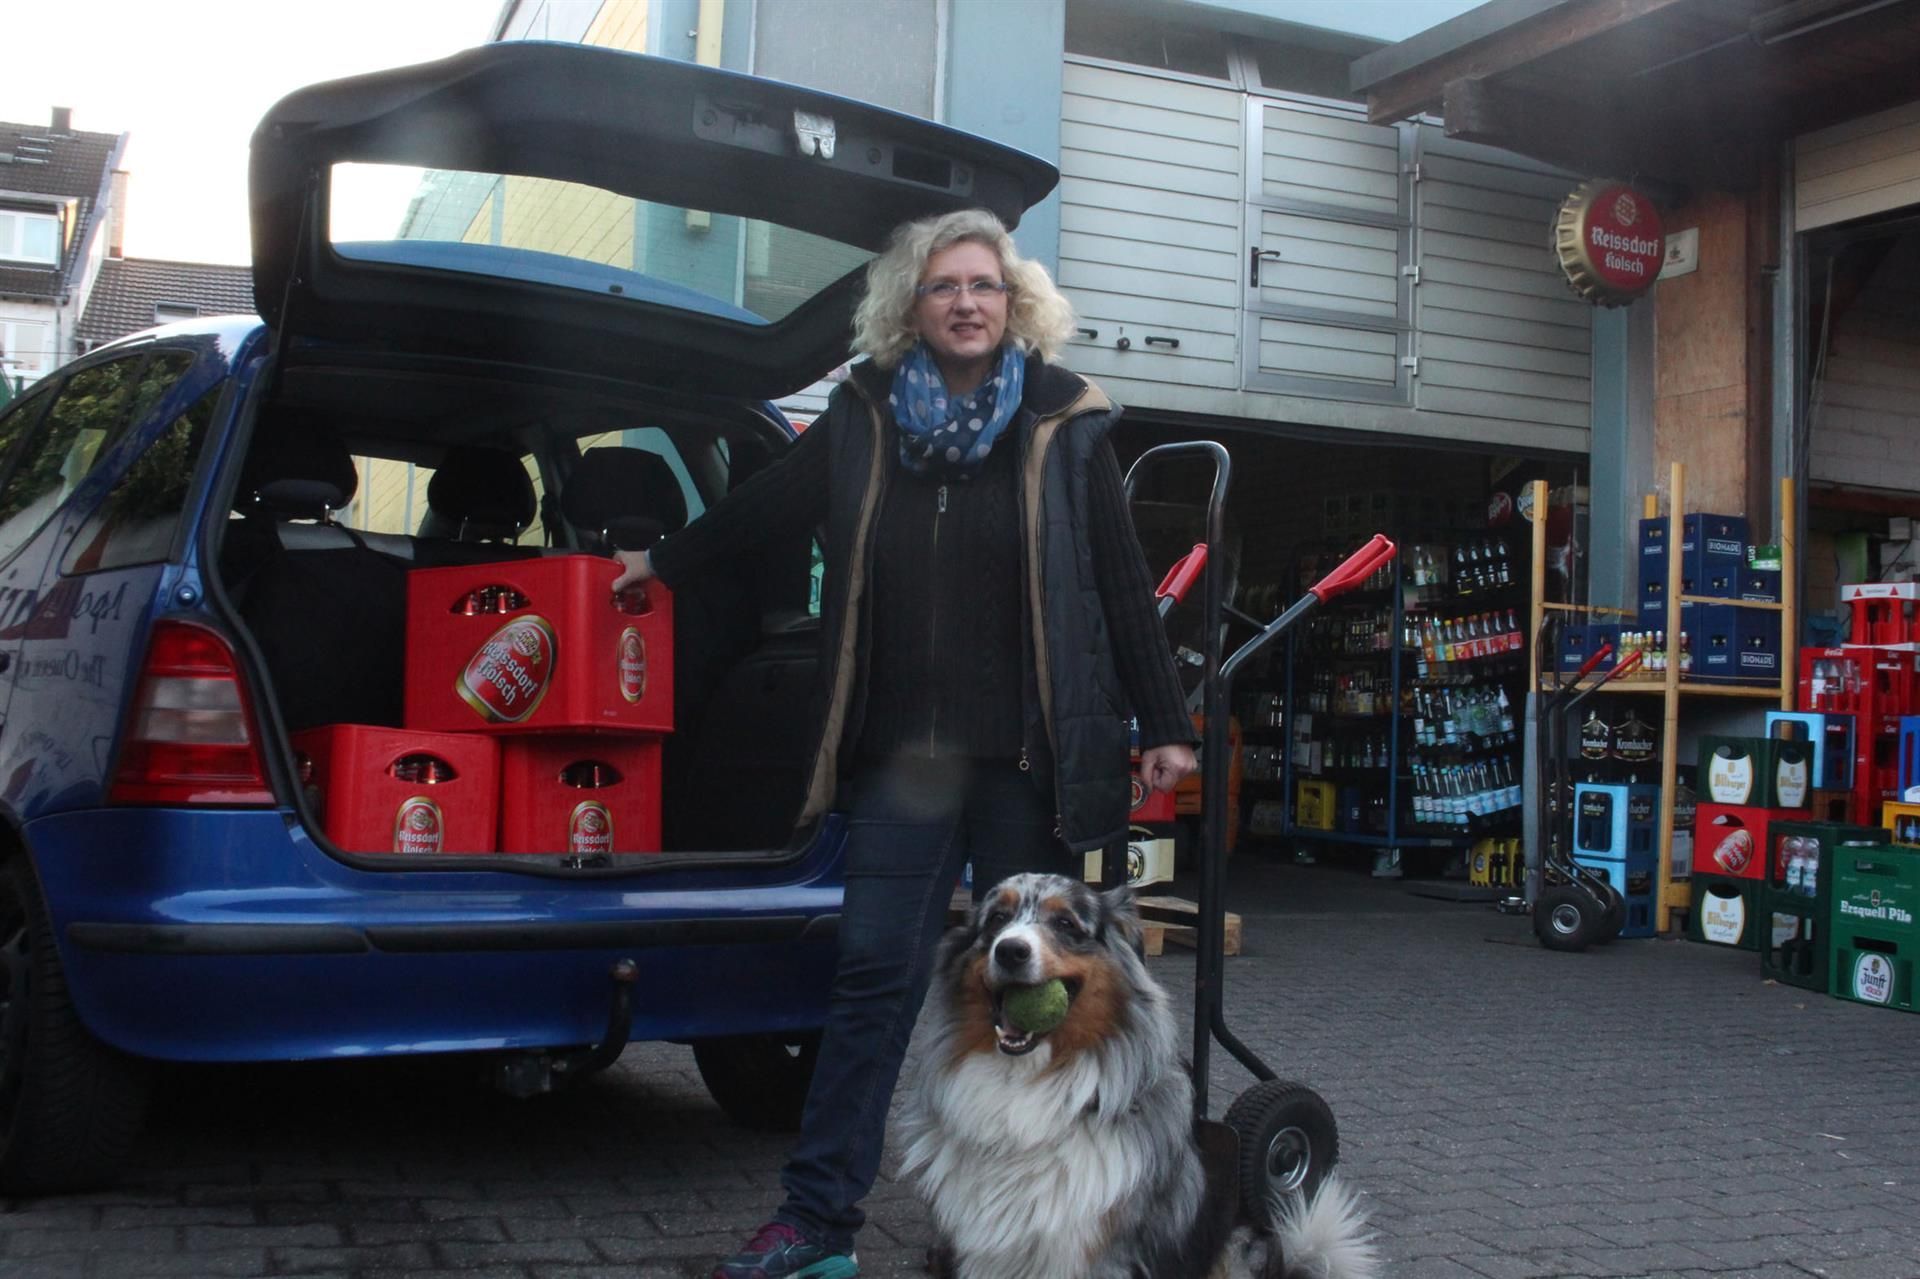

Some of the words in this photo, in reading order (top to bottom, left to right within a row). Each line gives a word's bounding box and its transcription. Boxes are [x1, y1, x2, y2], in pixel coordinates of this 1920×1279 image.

[1591, 226, 1659, 257] Reissdorf
[483, 641, 539, 699] Reissdorf
[399, 830, 440, 843] Reissdorf
